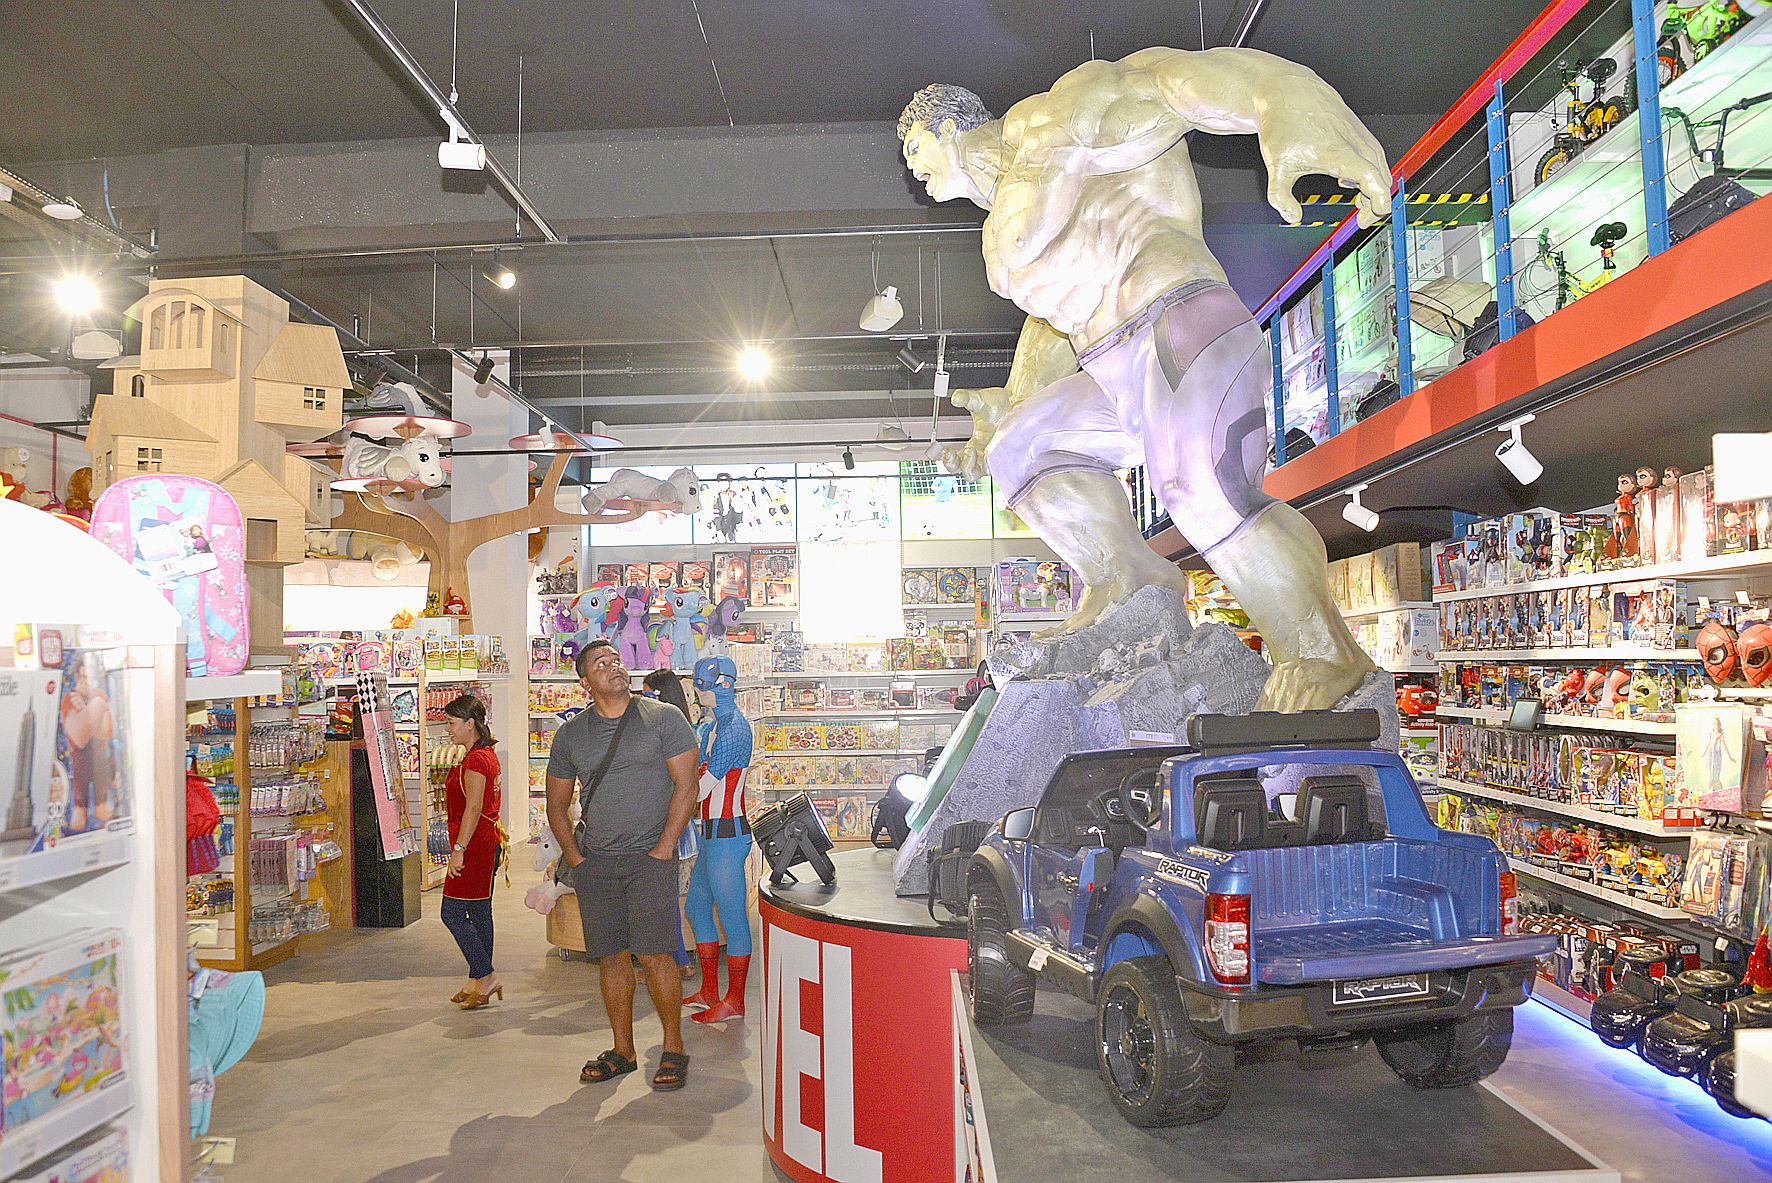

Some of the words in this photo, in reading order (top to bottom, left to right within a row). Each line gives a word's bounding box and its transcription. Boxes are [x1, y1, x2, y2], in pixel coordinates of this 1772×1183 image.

[1158, 859, 1210, 890] RAPTOR
[1679, 947, 1698, 955] WARS
[1343, 974, 1423, 999] RAPTOR
